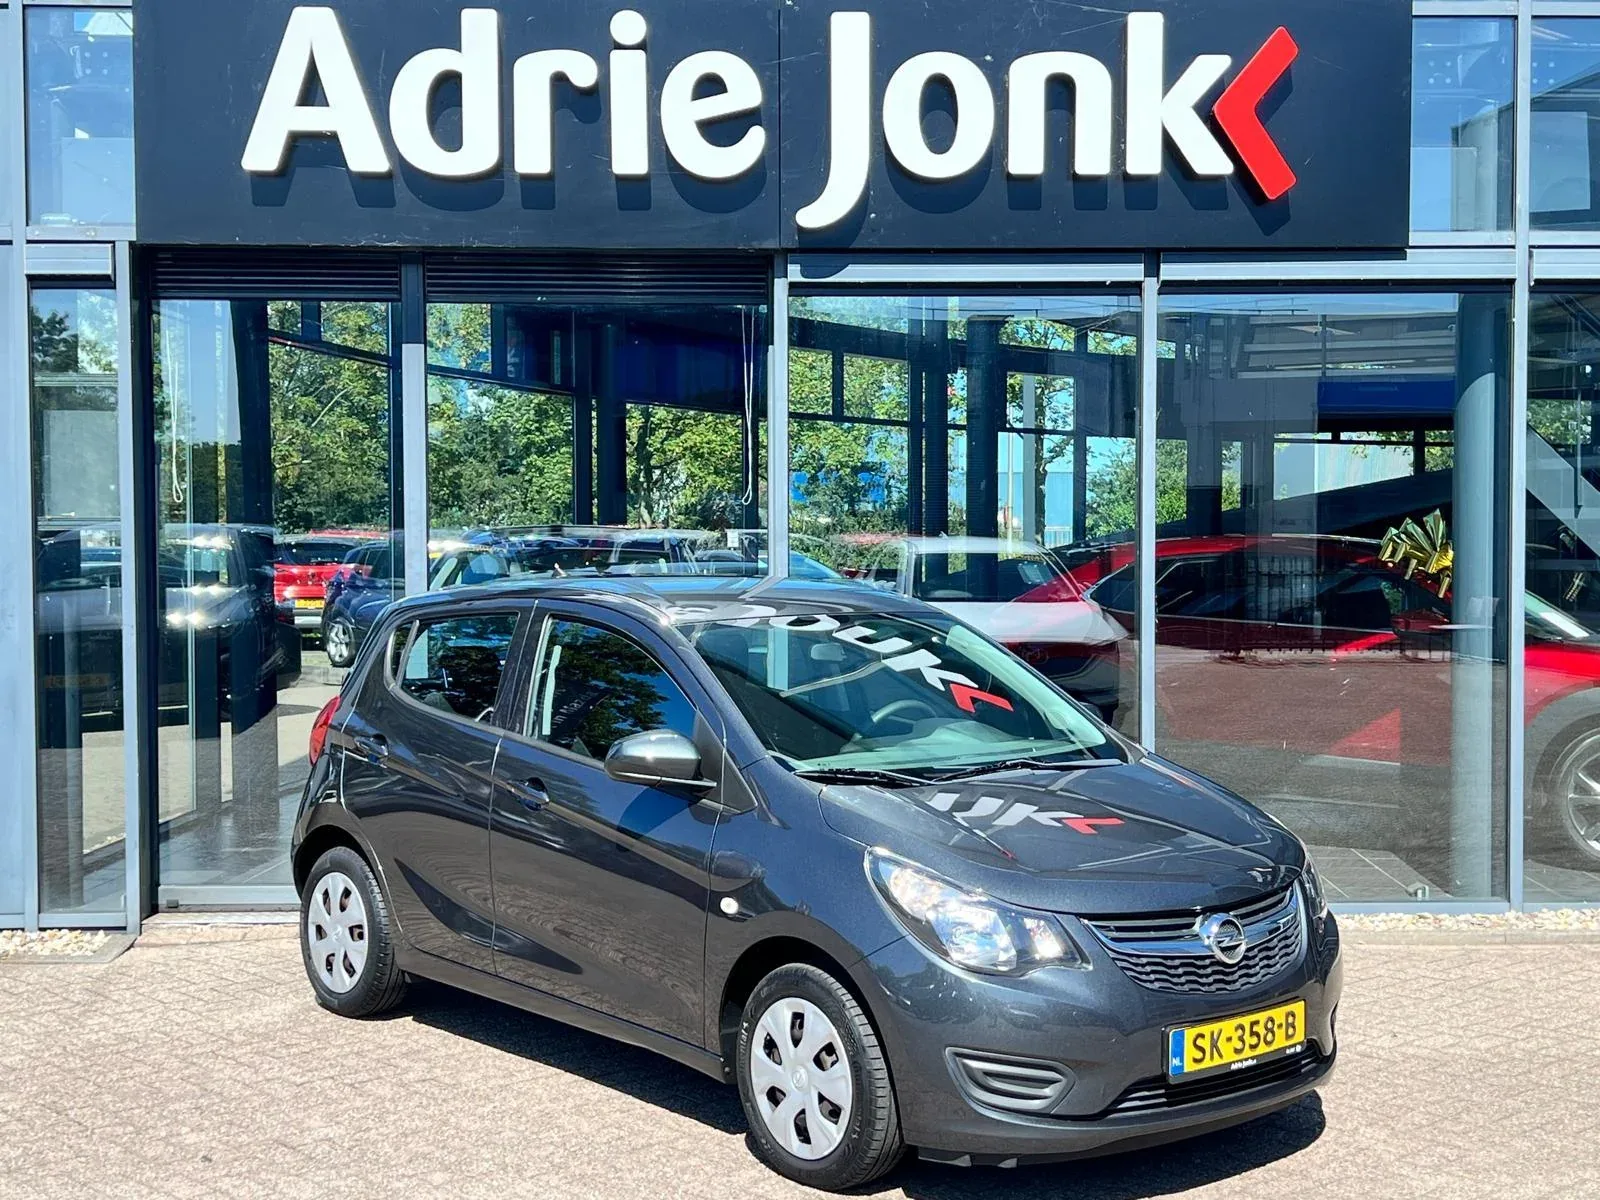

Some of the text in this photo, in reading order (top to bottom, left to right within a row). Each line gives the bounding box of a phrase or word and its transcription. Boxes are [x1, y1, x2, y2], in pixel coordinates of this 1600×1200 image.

[241, 6, 1234, 228] Adrie Jonk
[1171, 1056, 1183, 1067] NL
[1191, 1010, 1297, 1064] SK-358-B
